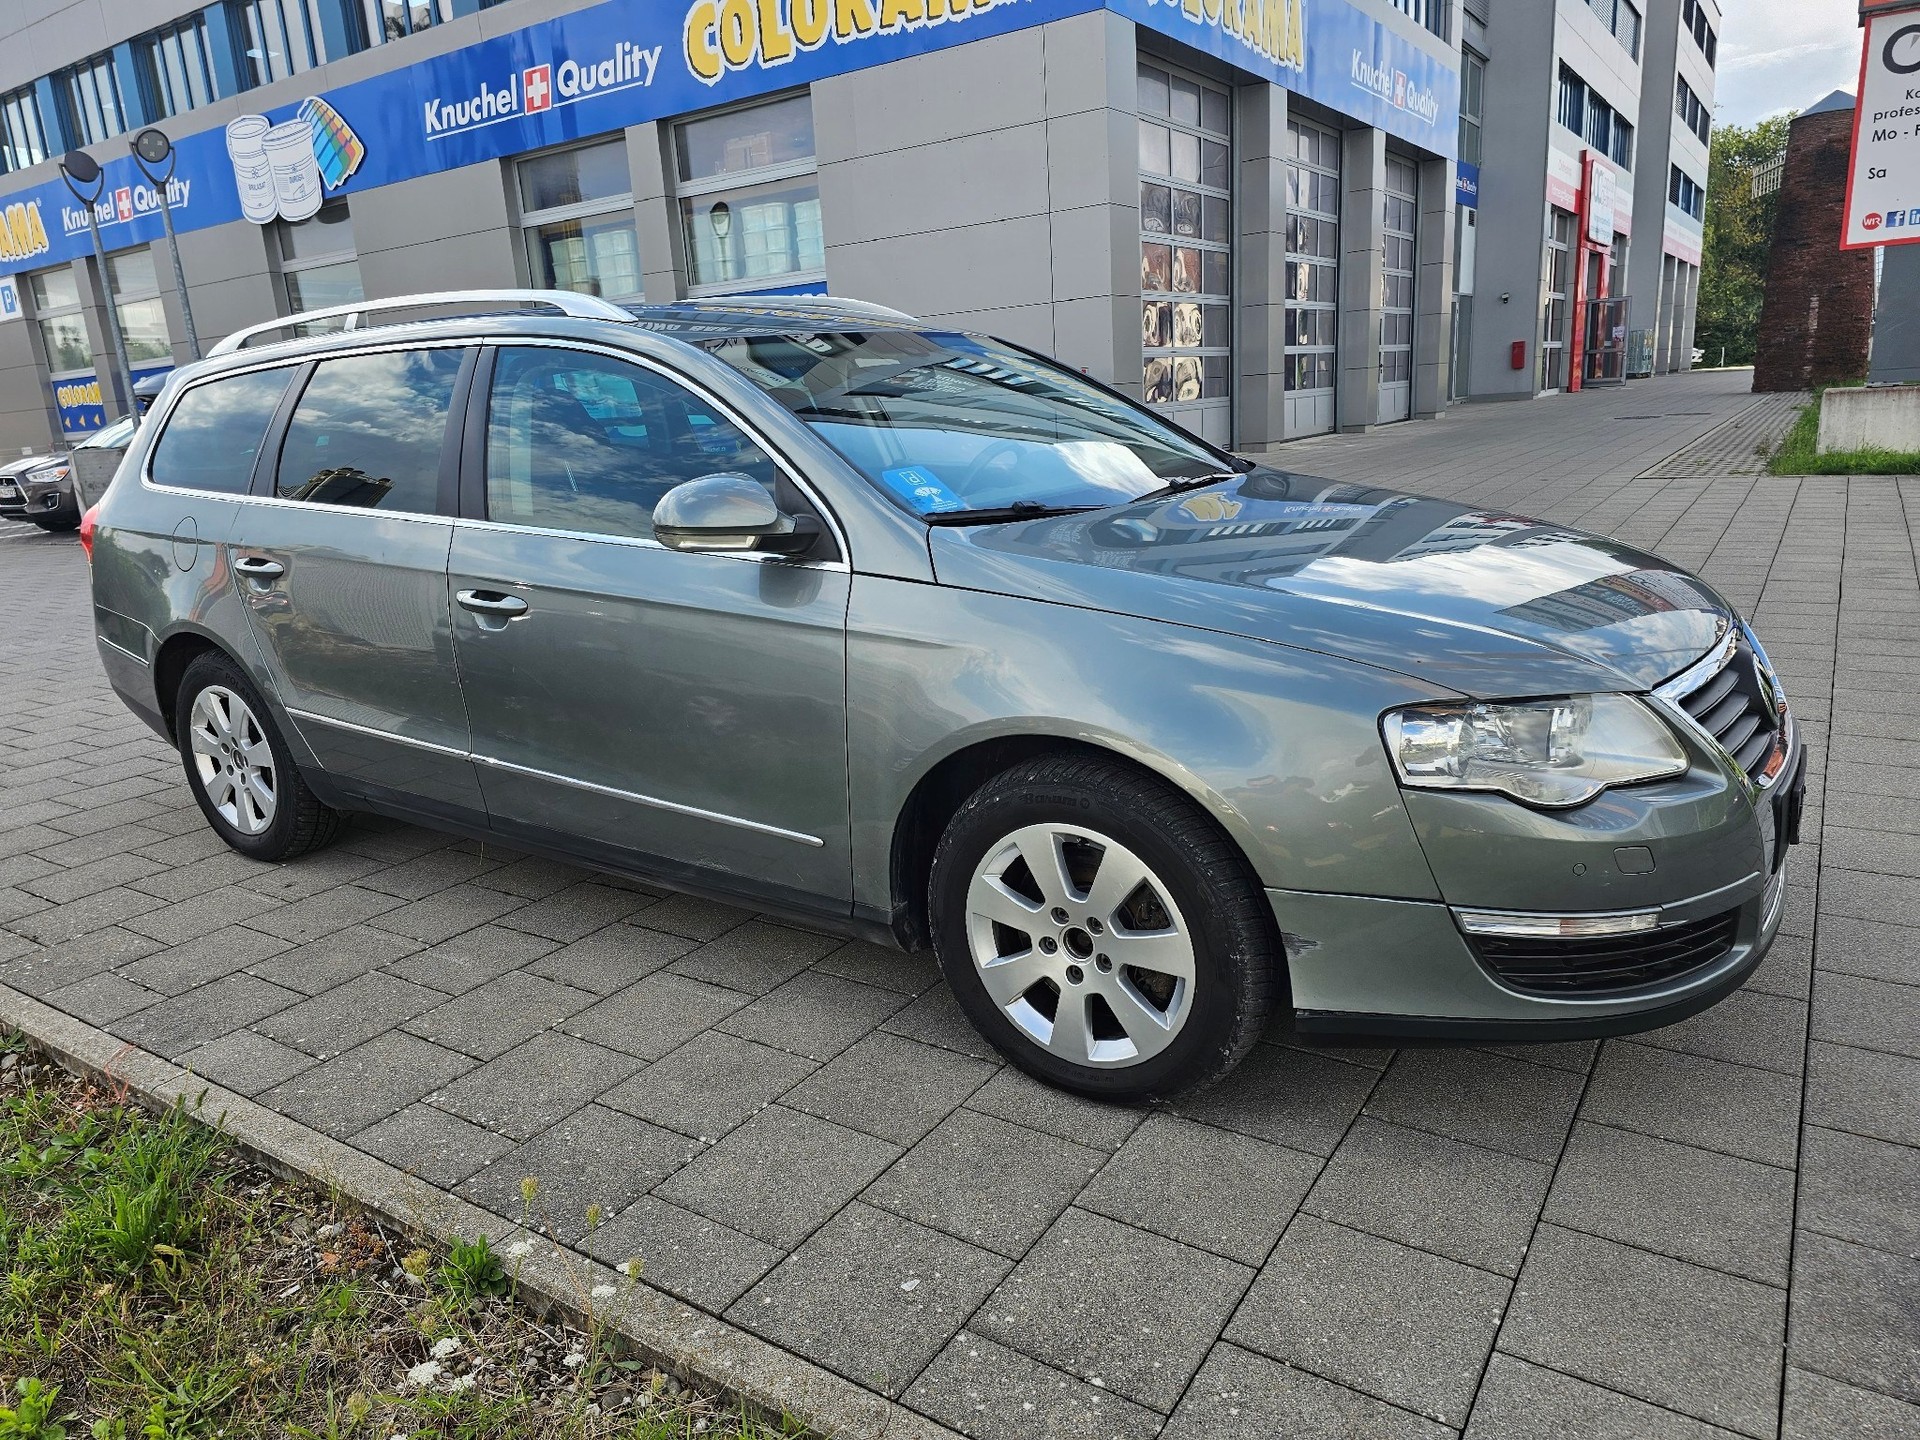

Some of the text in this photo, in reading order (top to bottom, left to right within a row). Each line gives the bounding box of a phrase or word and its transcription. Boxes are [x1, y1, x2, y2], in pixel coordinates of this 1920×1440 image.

[424, 42, 663, 134] Knuchel Quality
[1351, 48, 1439, 127] Knuchel Quality
[1872, 129, 1897, 142] Mo
[1867, 167, 1887, 180] Sa
[61, 191, 115, 231] Knuhel
